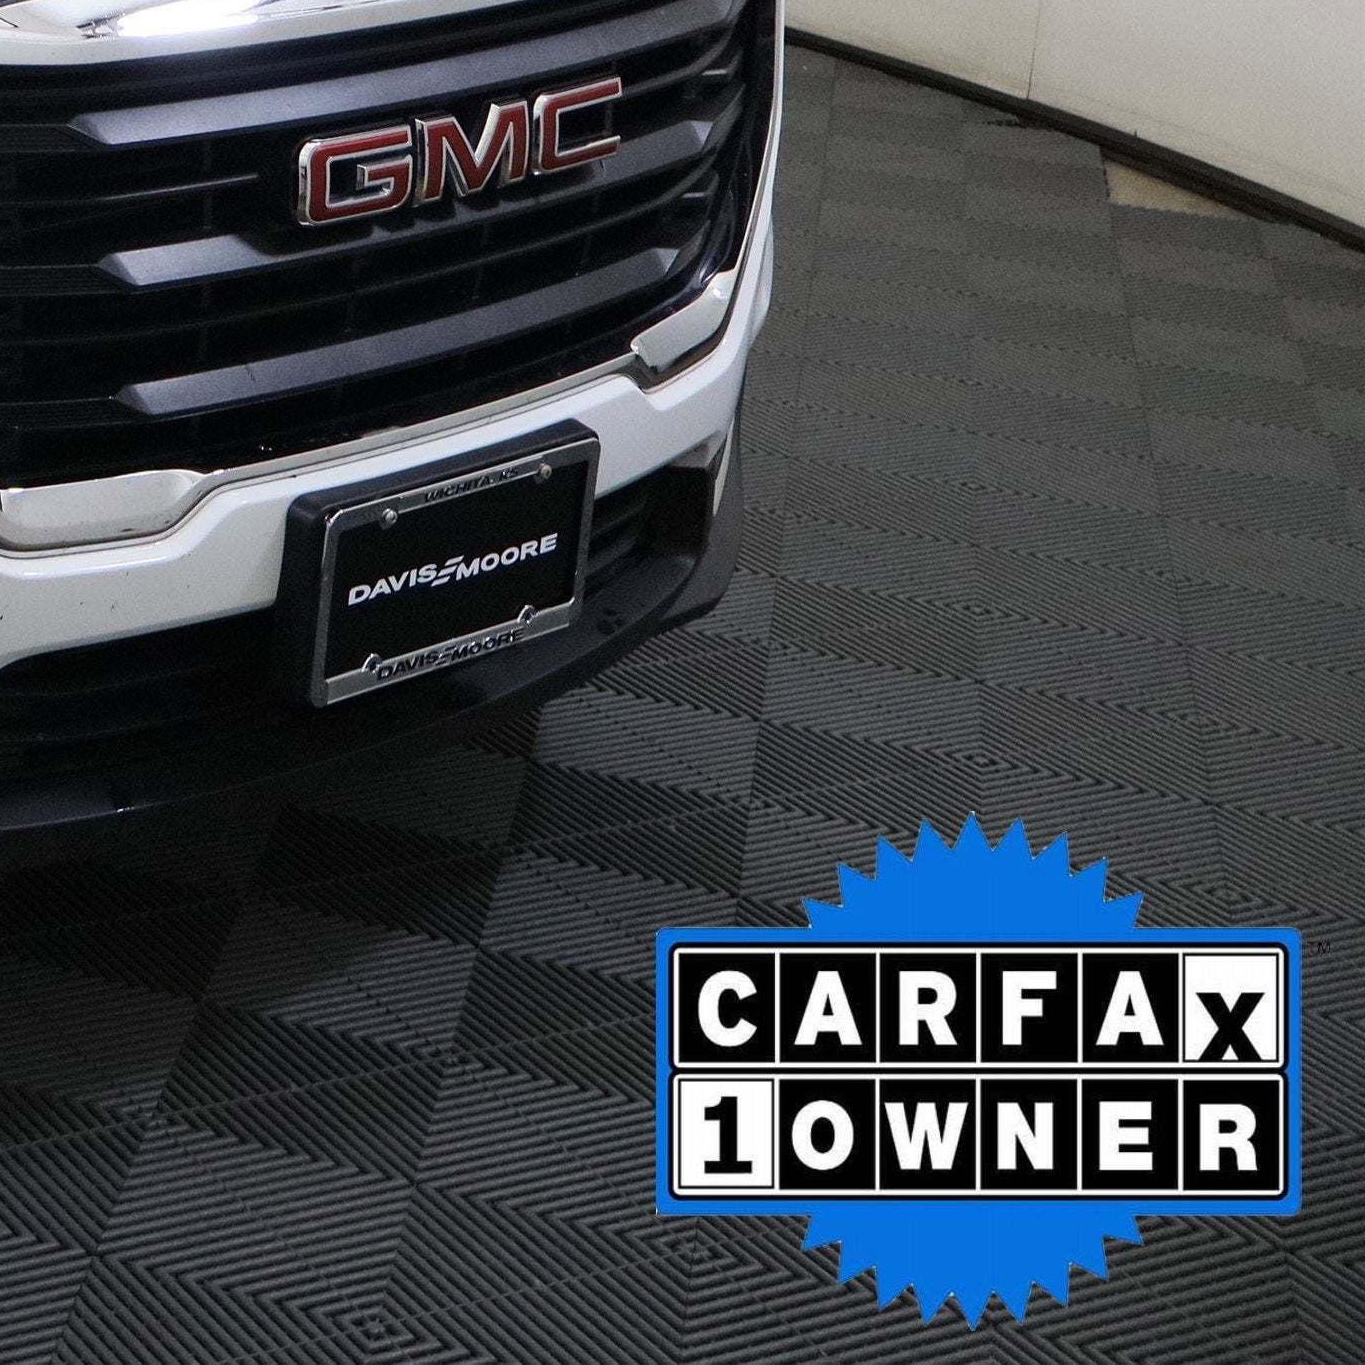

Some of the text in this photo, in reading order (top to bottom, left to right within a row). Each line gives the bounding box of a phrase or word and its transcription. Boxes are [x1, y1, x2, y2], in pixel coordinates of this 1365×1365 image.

[298, 76, 623, 226] GMC
[347, 532, 559, 606] DAVIS MOORE
[376, 627, 526, 681] DAVIS MOORE
